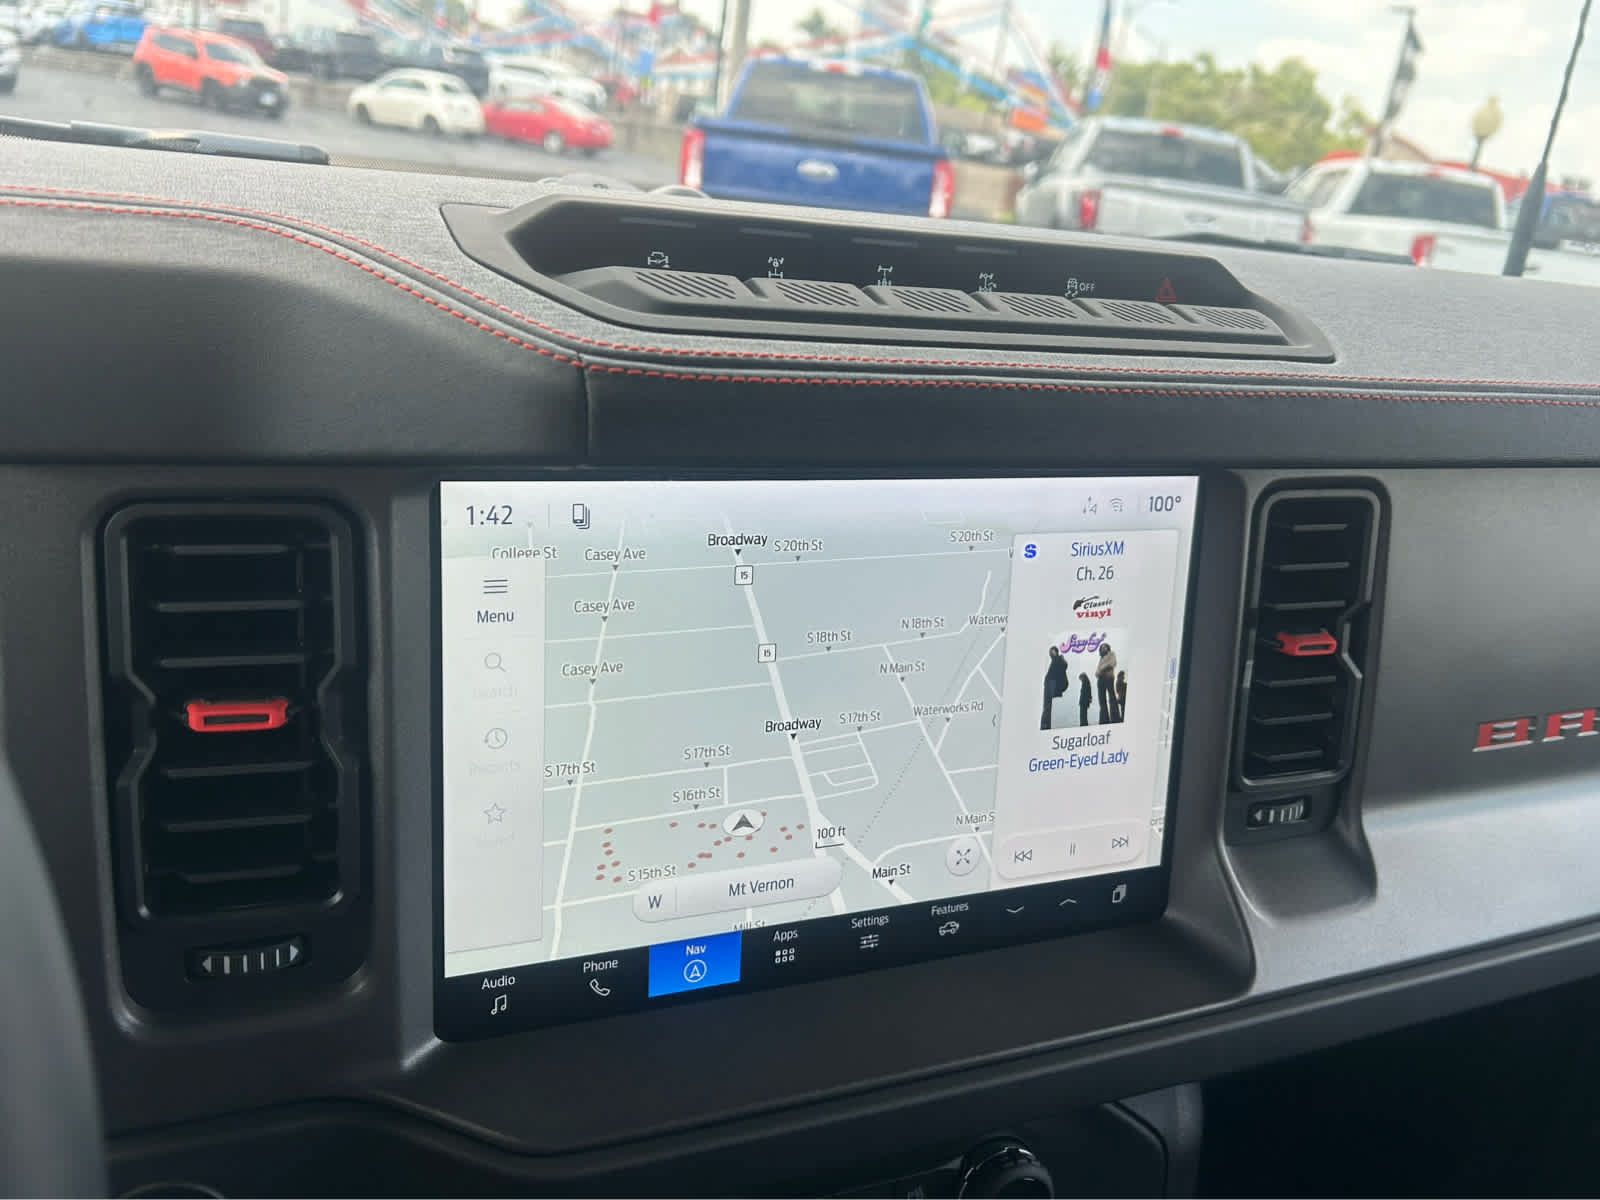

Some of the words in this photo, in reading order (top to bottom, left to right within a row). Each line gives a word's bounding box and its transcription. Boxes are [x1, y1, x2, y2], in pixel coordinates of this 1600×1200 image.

[1079, 282, 1095, 291] OFF
[465, 504, 513, 526] 1:42
[707, 532, 768, 548] Broadway
[950, 531, 957, 542] S
[957, 530, 982, 542] 20th
[983, 530, 994, 542] St
[543, 546, 558, 559] St
[774, 540, 780, 552] S
[782, 540, 809, 552] 20th
[811, 540, 823, 551] St
[1071, 541, 1125, 557] SiriusXM
[585, 549, 620, 563] Casey
[623, 548, 646, 560] Ave
[740, 571, 748, 580] 15
[1076, 566, 1095, 581] Ch.
[1098, 565, 1114, 580] 26
[574, 600, 610, 614] Casey
[612, 599, 636, 611] Ave
[1076, 608, 1112, 619] vinyl
[476, 610, 514, 624] Menu
[902, 619, 909, 630] N
[911, 618, 932, 629] 18th
[933, 617, 945, 628] St
[807, 632, 814, 644] S
[816, 632, 838, 643] 18th
[840, 630, 852, 642] St
[764, 649, 772, 658] 15
[562, 663, 598, 678] Casey
[600, 662, 624, 674] Ave
[880, 664, 888, 674] N
[889, 662, 914, 674] Main
[915, 661, 926, 672] St
[839, 713, 846, 724] S
[847, 712, 868, 724] 17th
[870, 710, 881, 722] St
[913, 703, 968, 717] Waterworks
[971, 702, 984, 712] Rd
[765, 718, 822, 734] Broadway
[1052, 730, 1112, 750] Sugarloaf
[684, 749, 691, 760] S
[694, 747, 716, 758] 17th
[718, 745, 730, 756] St
[1028, 752, 1098, 772] Green-Eyed
[1100, 750, 1129, 765] Lady
[544, 766, 552, 778] S
[555, 764, 580, 776] 17th
[583, 762, 596, 774] St
[672, 792, 680, 802] S
[682, 790, 706, 802] 16th
[708, 788, 720, 799] St
[956, 816, 963, 826] N
[964, 814, 987, 825] Main
[816, 827, 836, 840] 100
[837, 826, 846, 838] ft
[628, 870, 635, 882] S
[638, 868, 662, 880] 15th
[664, 866, 676, 878] St
[872, 866, 896, 880] Main
[898, 864, 912, 876] St
[728, 882, 746, 898] Mt
[748, 876, 794, 894] Vernon
[648, 894, 662, 909] W
[931, 901, 969, 916] Features
[851, 913, 889, 929] Settings
[773, 930, 798, 943] Apps
[686, 944, 706, 956] Nav
[583, 958, 619, 974] Phone
[481, 976, 516, 990] Audio
